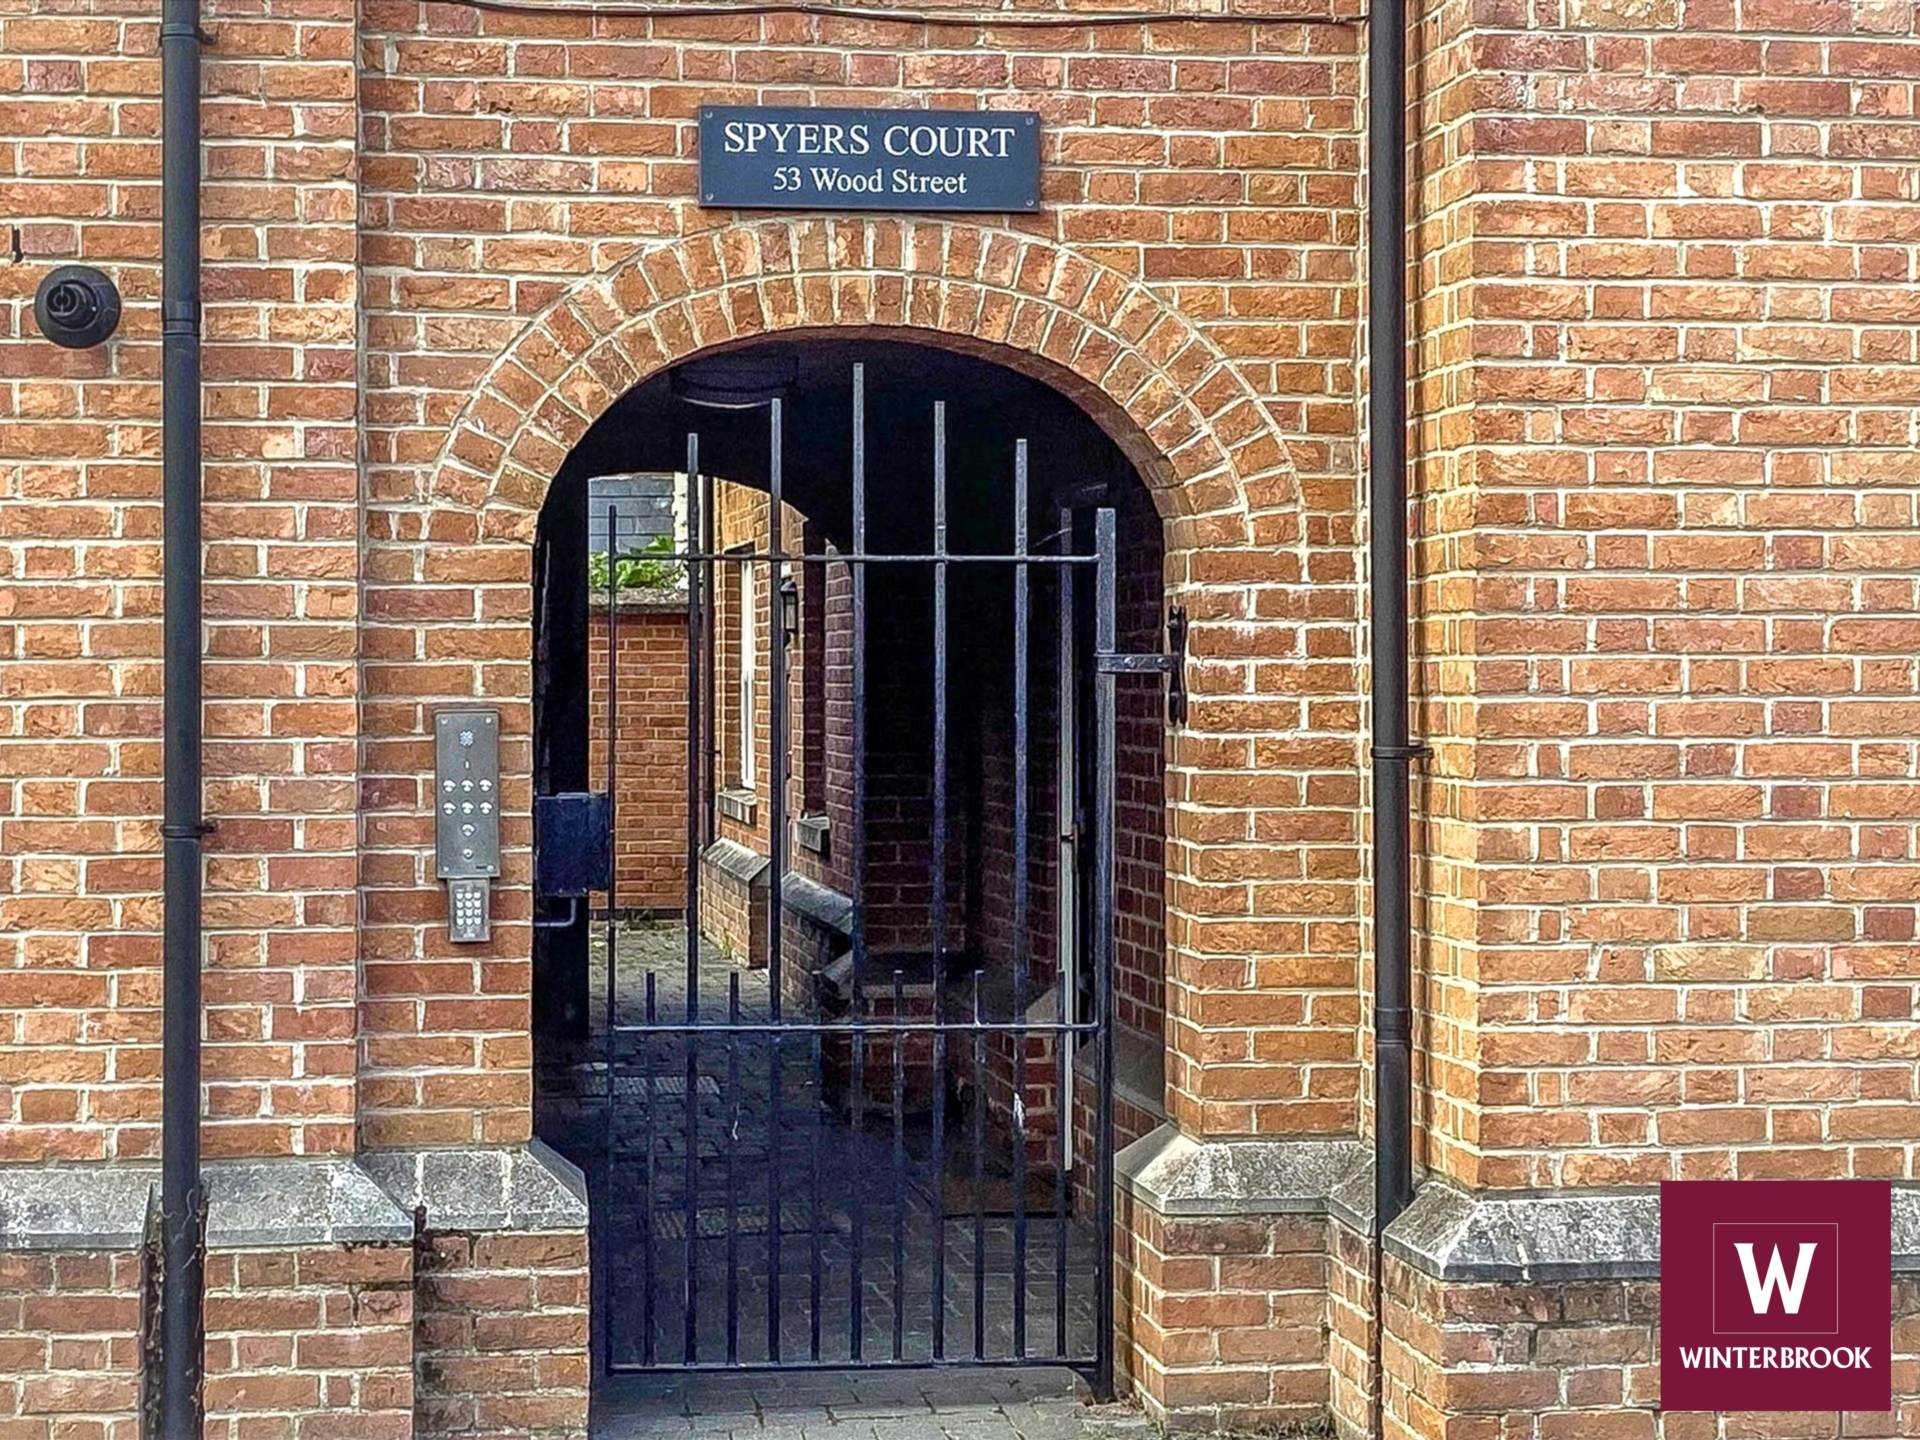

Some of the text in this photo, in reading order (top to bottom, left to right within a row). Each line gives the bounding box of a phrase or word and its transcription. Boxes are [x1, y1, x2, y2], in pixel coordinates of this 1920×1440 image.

[724, 121, 1016, 158] SPYERS COURT
[773, 166, 968, 194] 53 Wood Street
